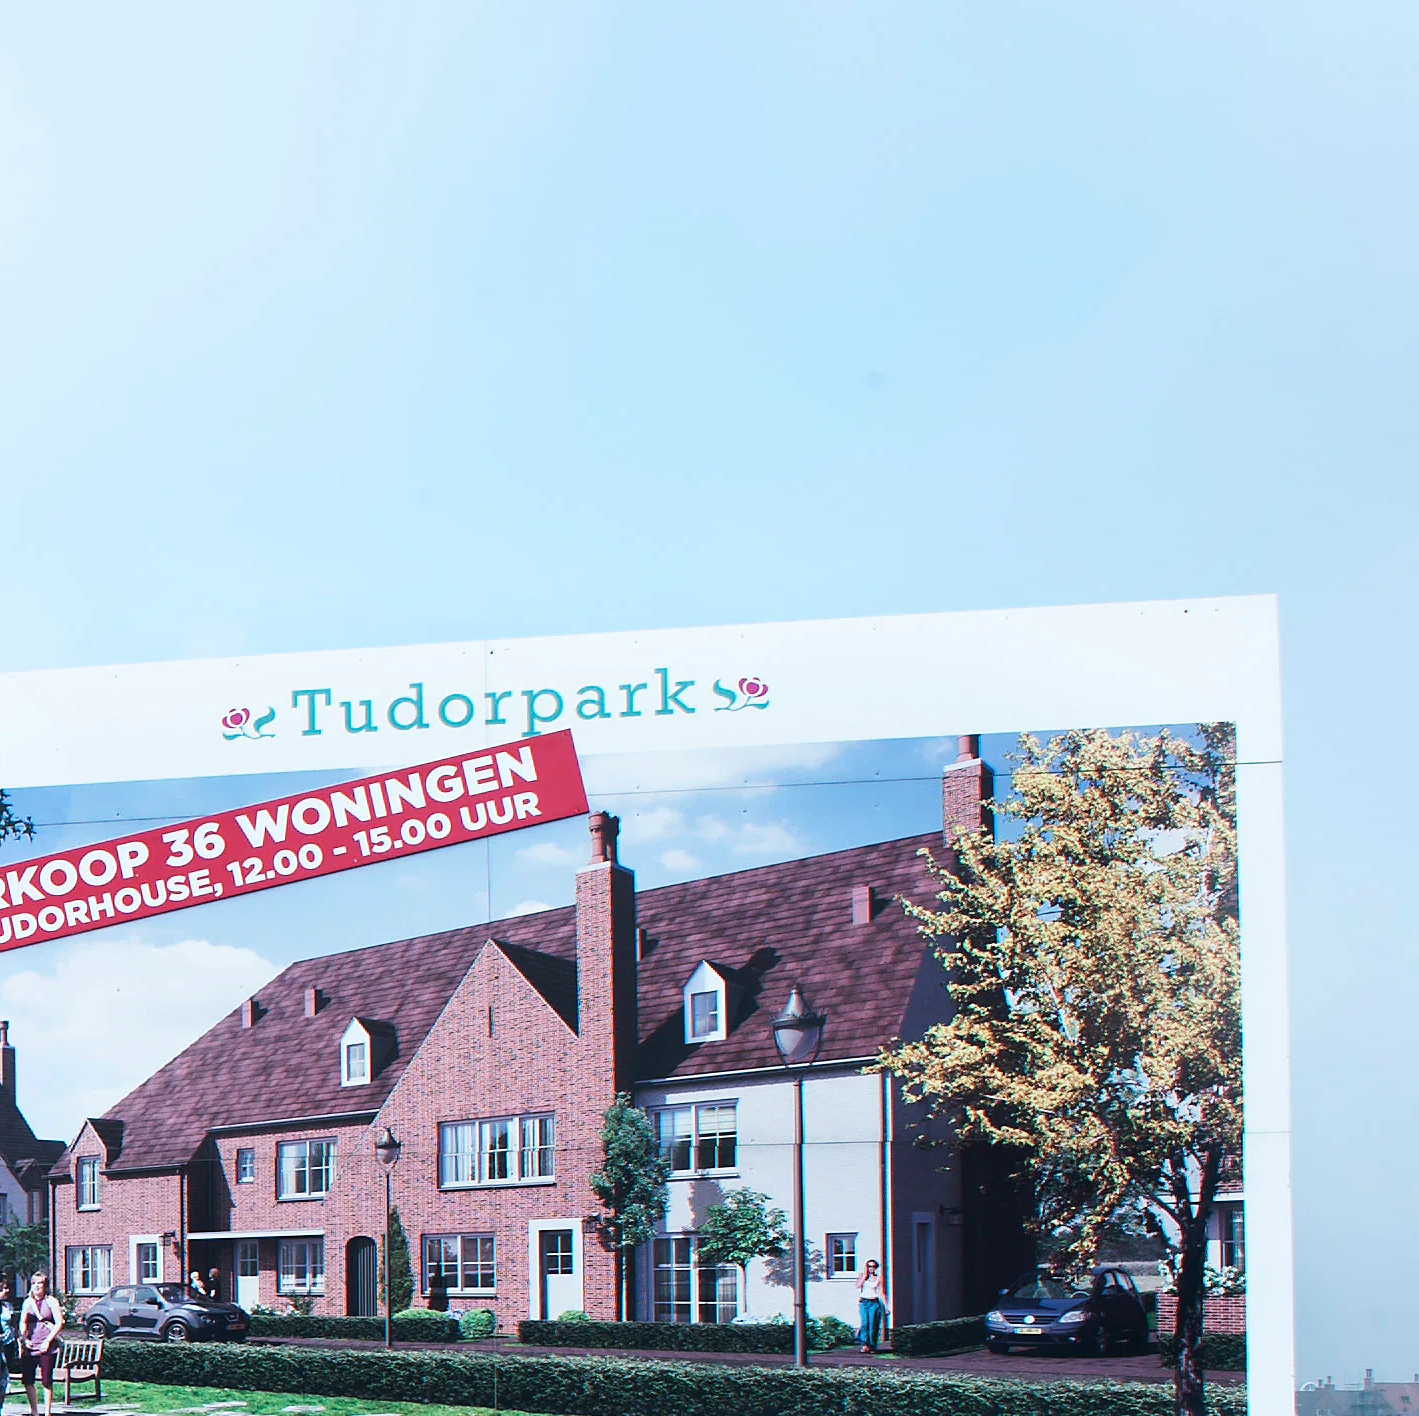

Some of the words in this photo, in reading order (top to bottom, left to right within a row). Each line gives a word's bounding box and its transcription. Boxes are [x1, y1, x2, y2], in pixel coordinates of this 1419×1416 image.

[291, 667, 696, 738] Tudorpark
[162, 822, 226, 867] 36
[235, 745, 539, 849] WONINGEN
[227, 843, 324, 887] 12.00
[332, 846, 347, 856] -
[353, 812, 453, 857] 15.00
[459, 791, 543, 832] UUR
